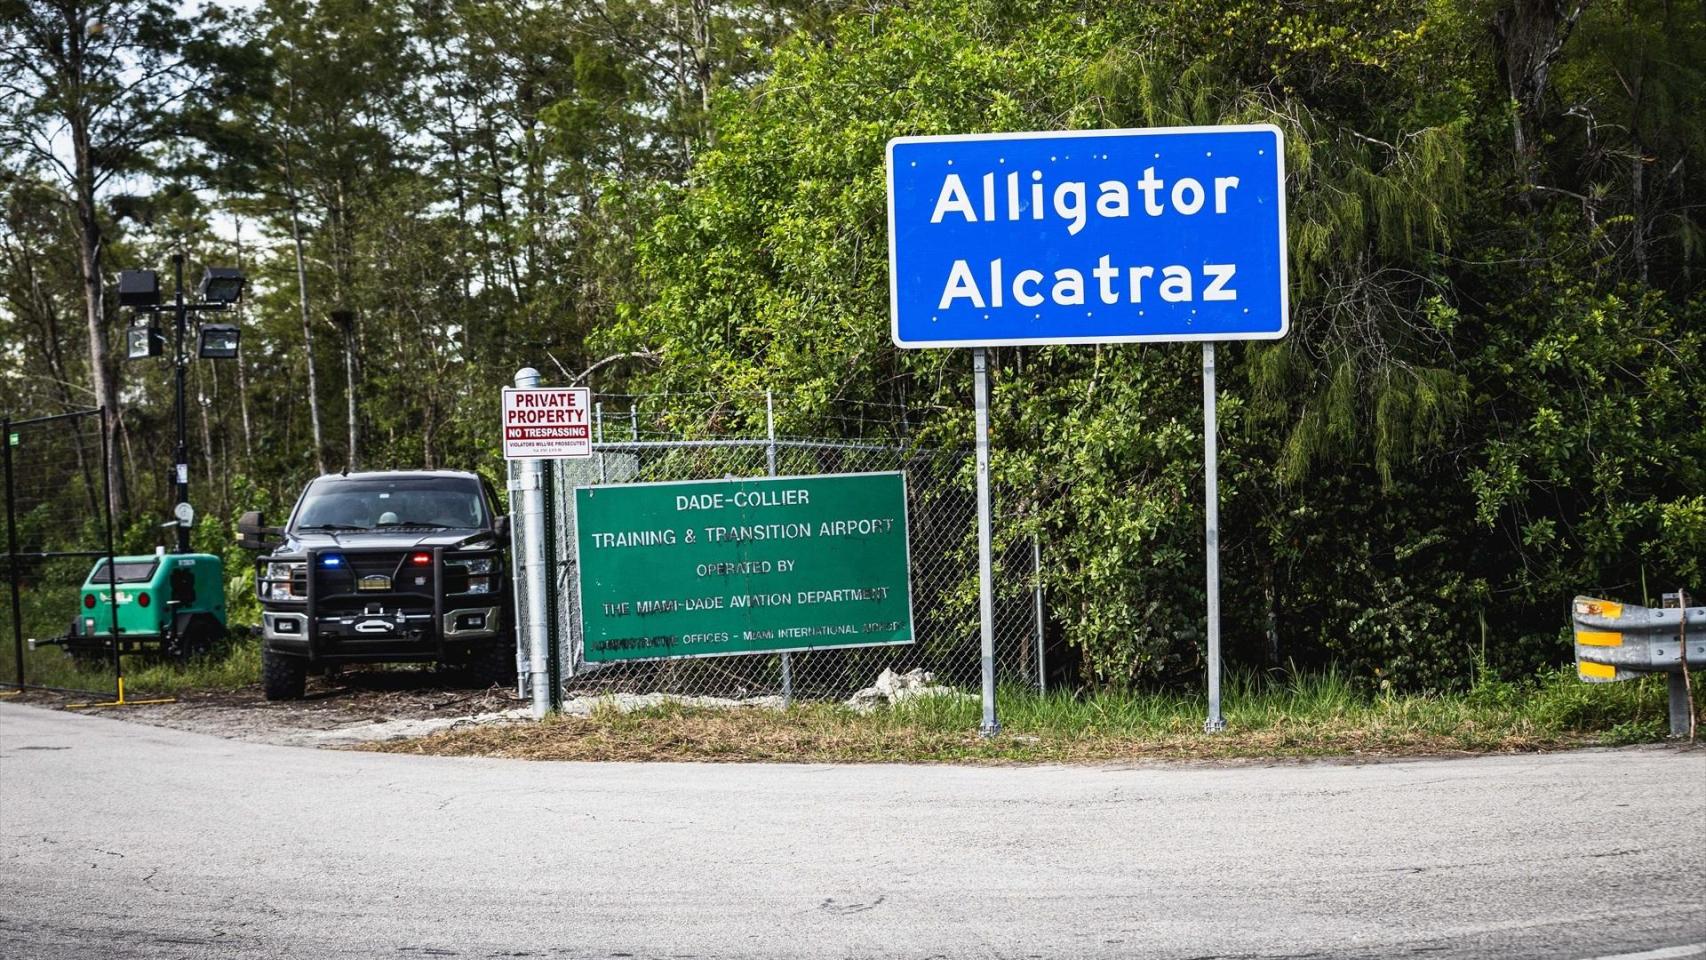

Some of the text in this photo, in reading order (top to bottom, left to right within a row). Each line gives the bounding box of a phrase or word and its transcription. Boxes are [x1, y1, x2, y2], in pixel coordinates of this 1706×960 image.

[930, 166, 1240, 236] Alligator
[938, 254, 1237, 310] Alcatraz
[516, 393, 576, 407] PRIVATE
[508, 409, 584, 424] PROPERTY
[508, 427, 586, 438] NO TRESPASSING
[676, 489, 810, 511] DADE-COLLIER
[592, 518, 894, 549] TRAINING & TRANSITION AIRPORT
[696, 559, 795, 578] OPERATED BY
[603, 586, 890, 617] THE MIAMI-DADE AVIATION DEPARTMENT
[683, 632, 729, 644] OFFICES
[743, 629, 774, 641] MIAMI
[778, 624, 859, 638] INTERNATIONAL
